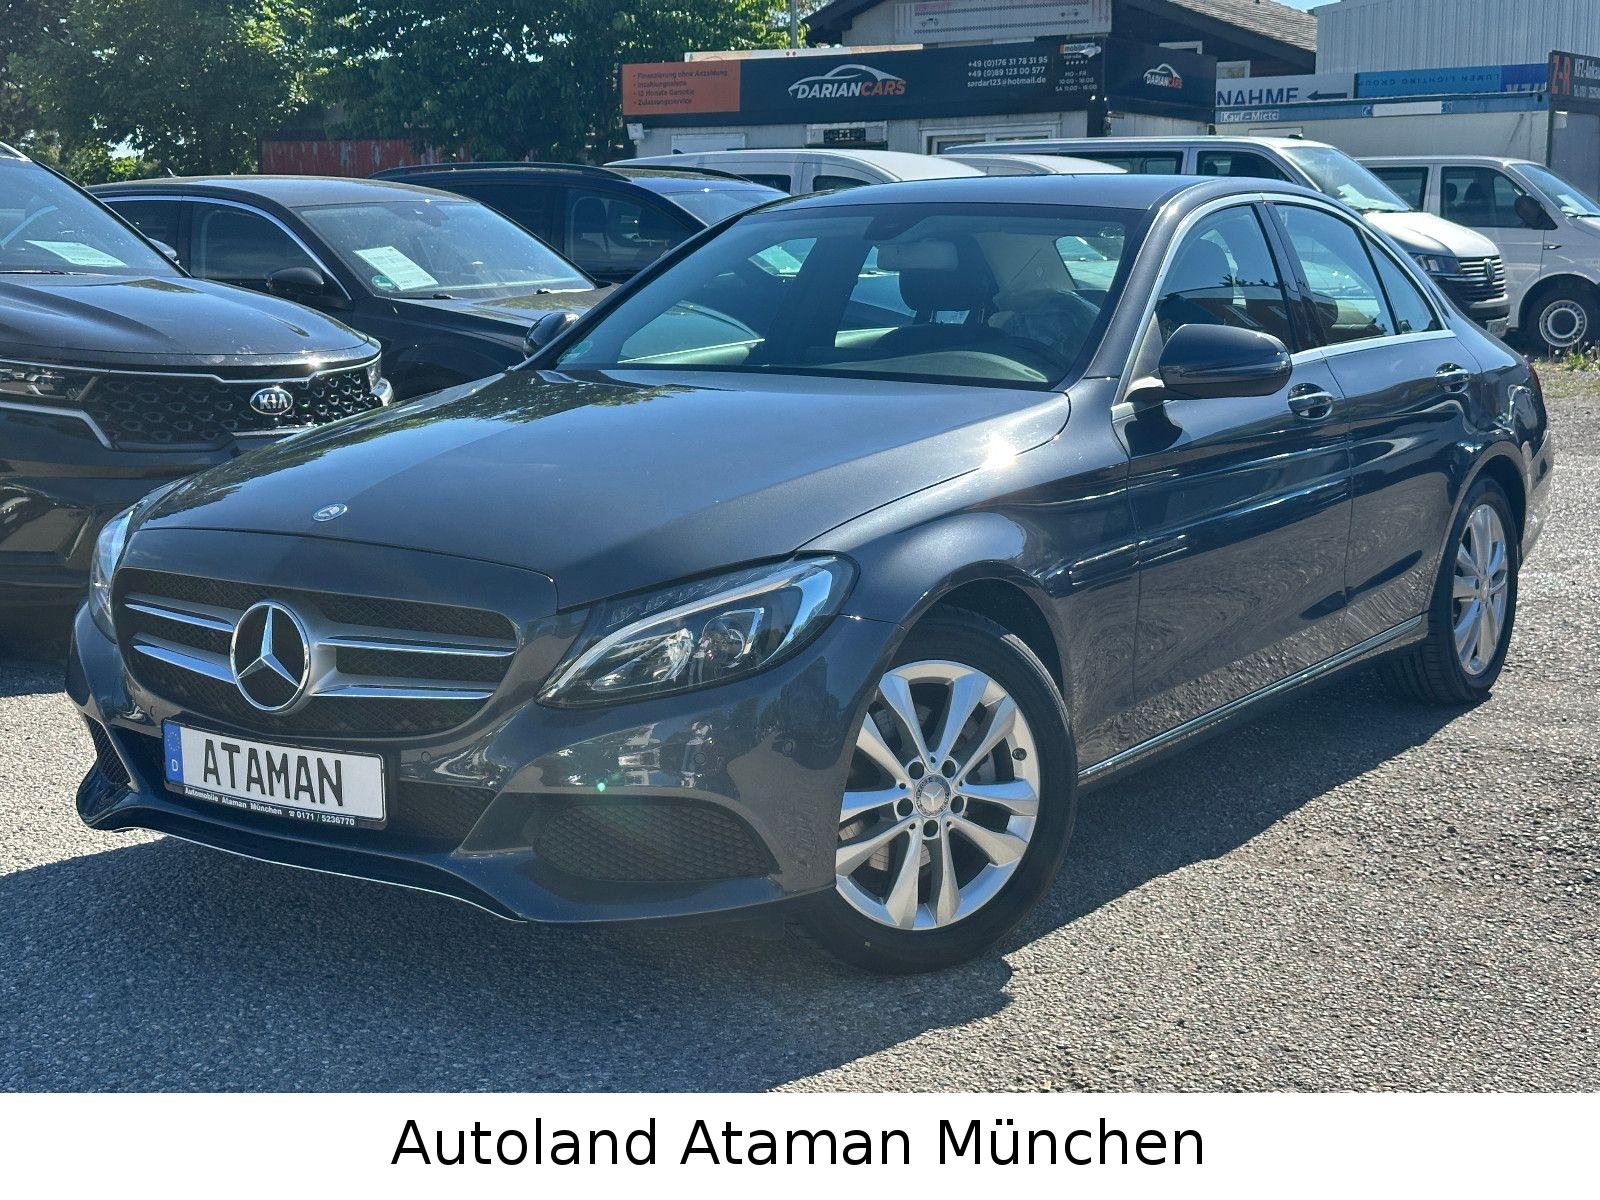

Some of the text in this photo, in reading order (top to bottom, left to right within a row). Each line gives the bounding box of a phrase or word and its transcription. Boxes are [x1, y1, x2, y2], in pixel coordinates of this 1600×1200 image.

[968, 56, 1048, 68] +49 (0)176 31 78 31 95
[983, 69, 1004, 77] (0)89
[1005, 67, 1018, 75] 123
[1031, 66, 1045, 74] 577
[797, 80, 907, 99] DARIANCARS
[258, 393, 288, 410] KIA
[171, 760, 179, 772] D
[204, 739, 343, 806] ATAMAN
[185, 788, 219, 802] Automobile
[222, 798, 248, 809] Ataman
[251, 803, 283, 815] München
[296, 810, 315, 821] 0171
